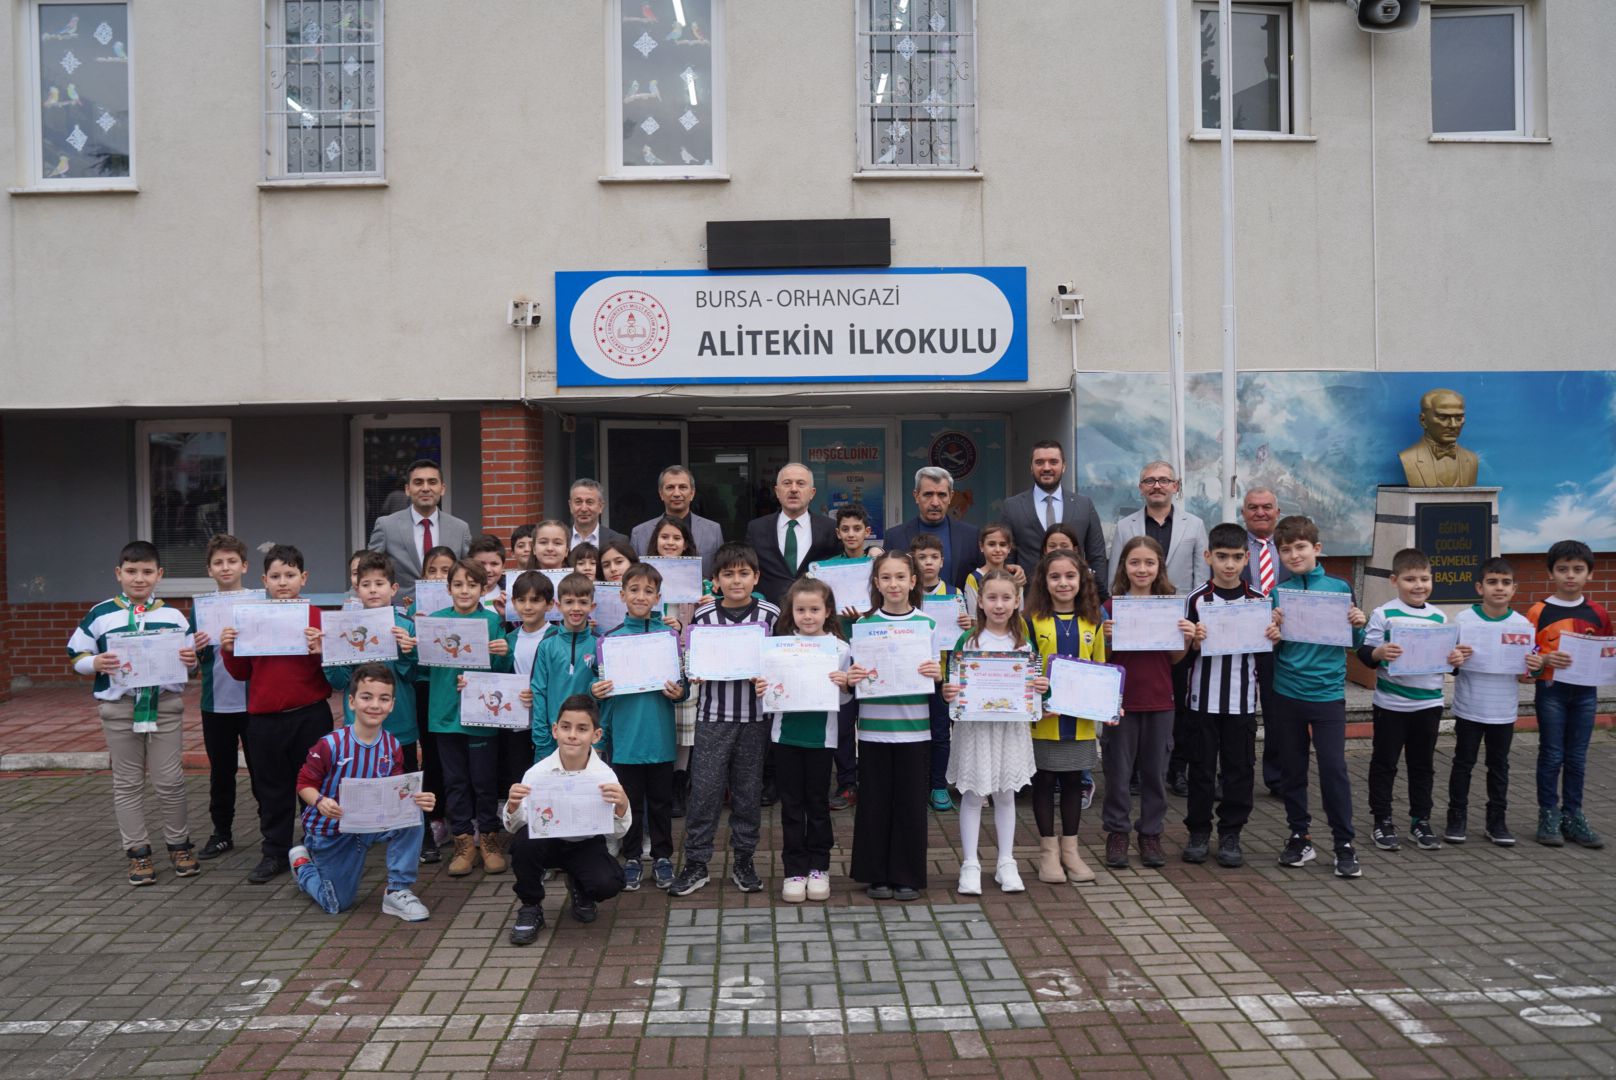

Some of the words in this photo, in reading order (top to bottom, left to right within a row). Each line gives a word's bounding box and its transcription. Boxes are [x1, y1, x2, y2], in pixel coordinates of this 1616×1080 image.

[695, 290, 763, 308] BURSA
[776, 285, 900, 307] ORHANGAZİ
[697, 323, 833, 357] ALİTEKİN
[849, 322, 997, 355] İLKOKULU
[1440, 522, 1468, 533] EĞİTİM
[1436, 538, 1471, 552] ÇOCUĞU
[1430, 555, 1478, 566] SEVMEKLE
[1435, 572, 1471, 585] BAŞLAR
